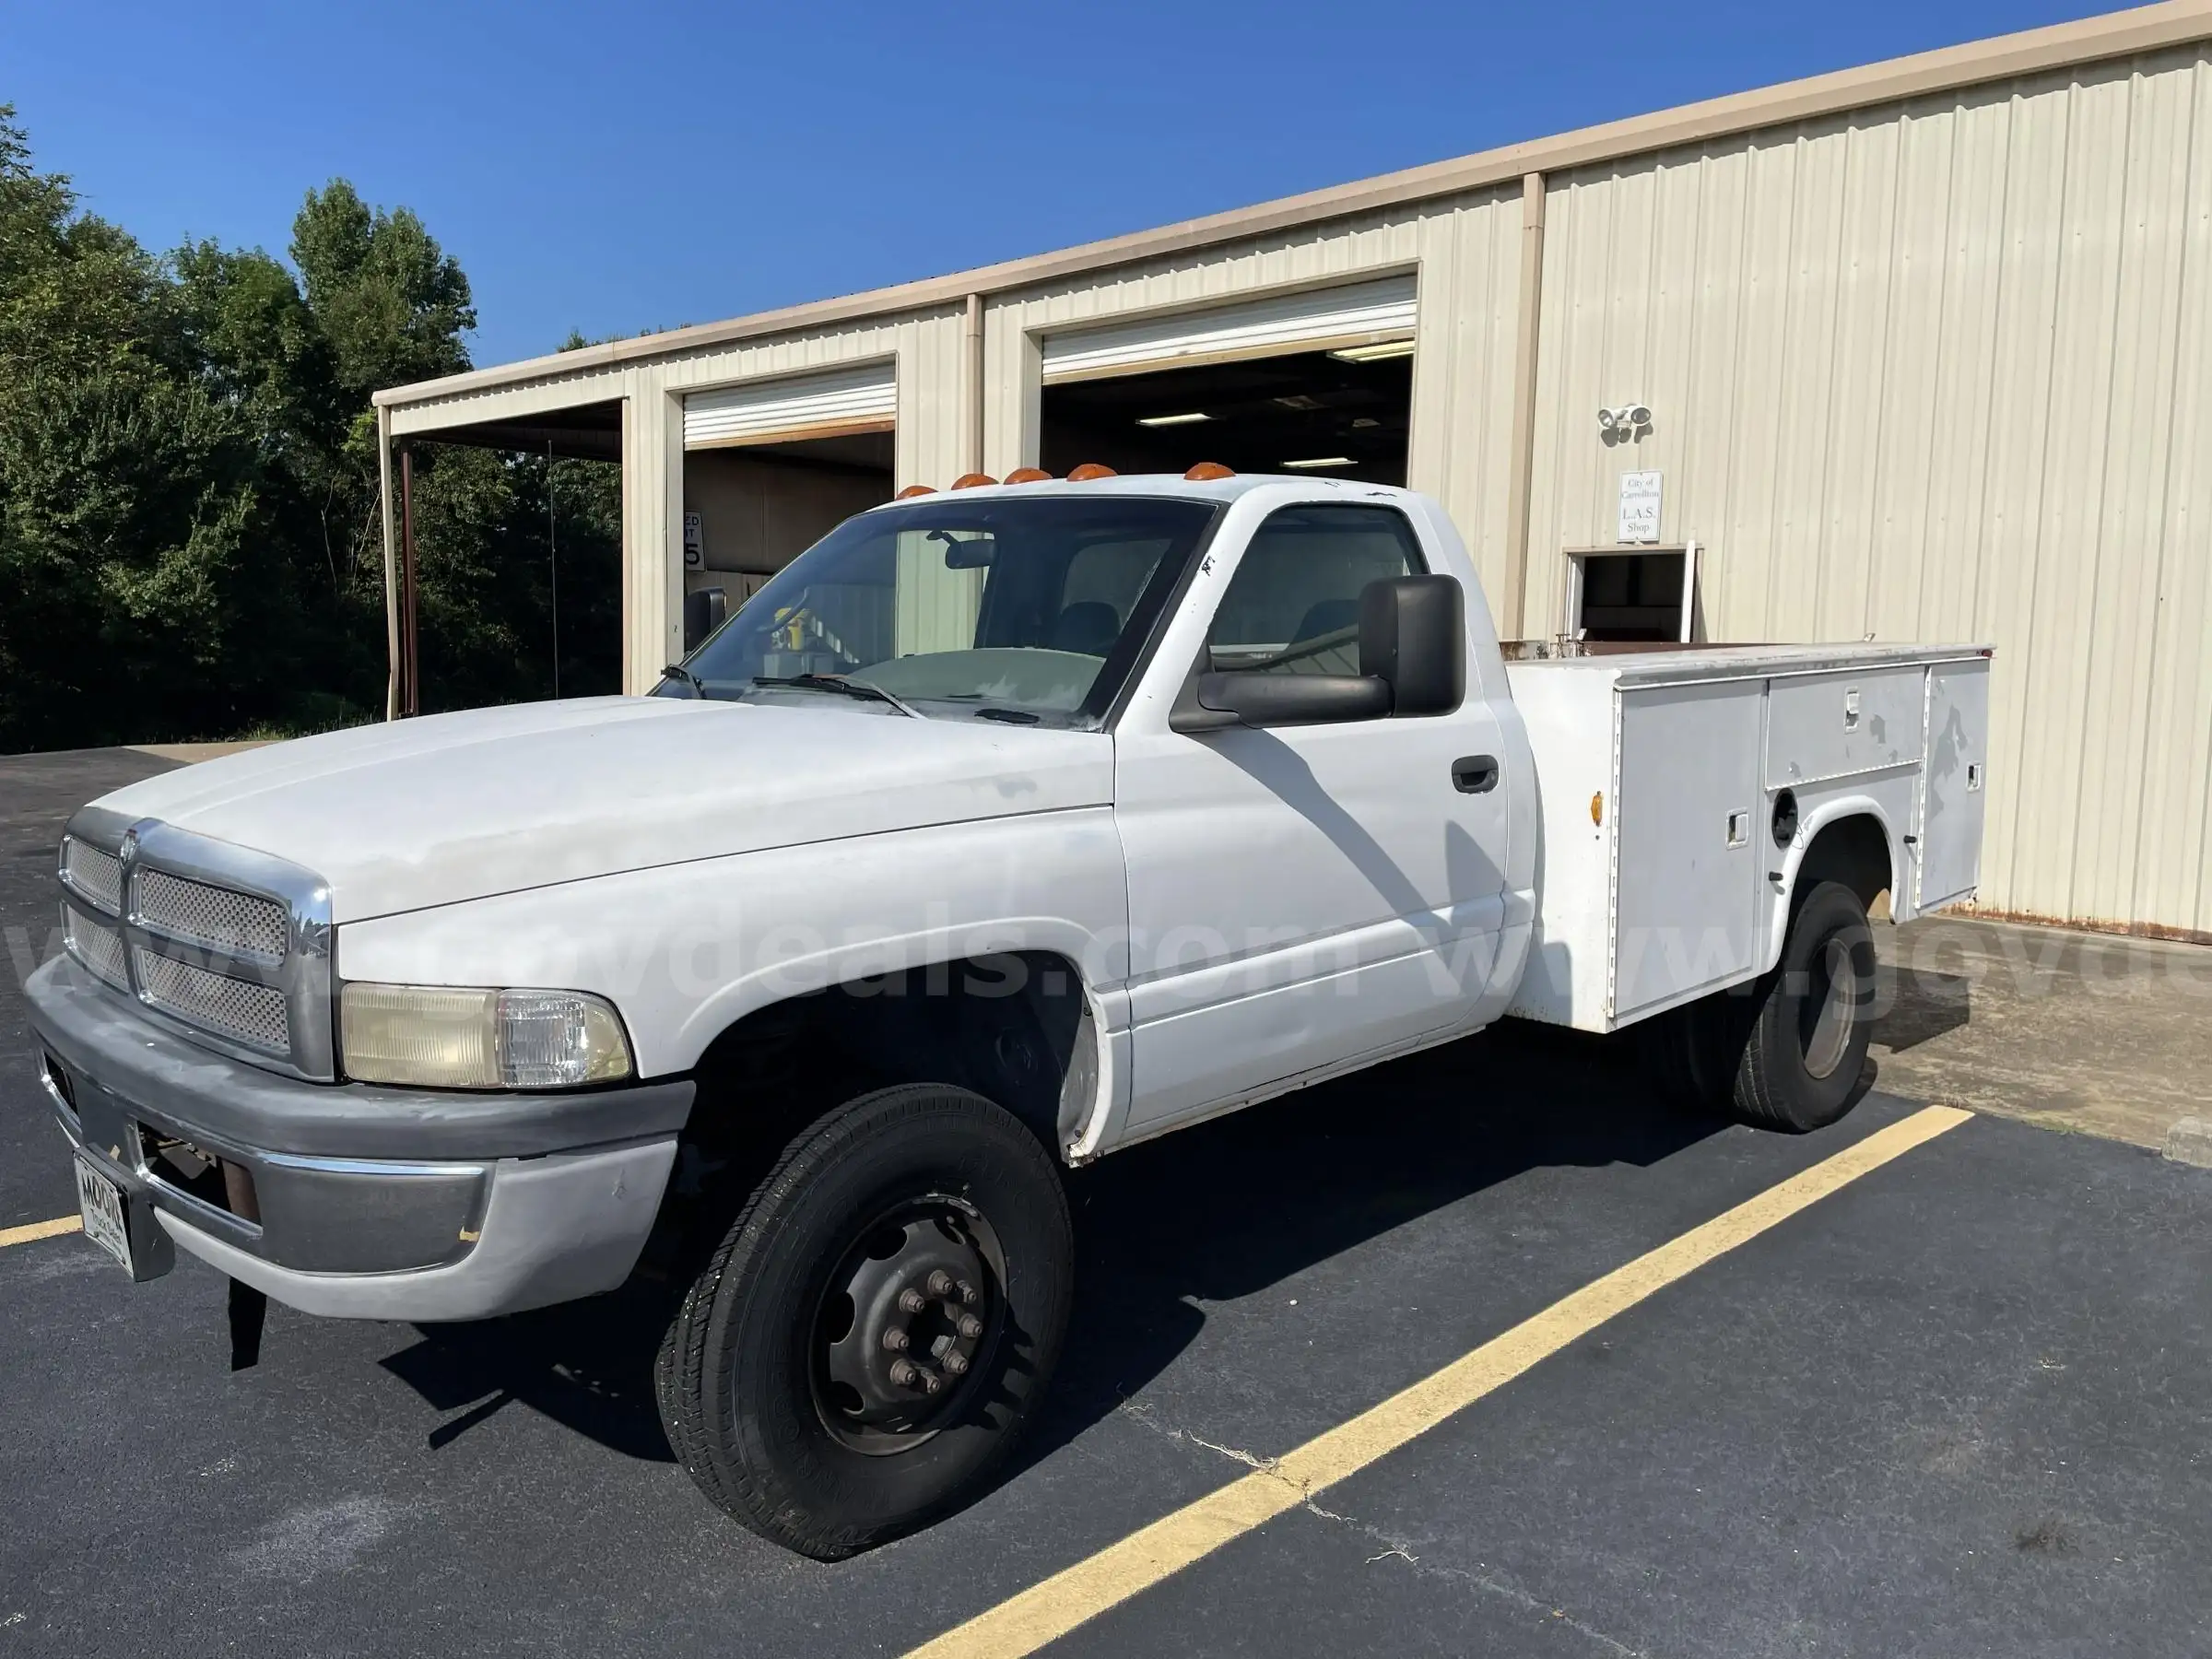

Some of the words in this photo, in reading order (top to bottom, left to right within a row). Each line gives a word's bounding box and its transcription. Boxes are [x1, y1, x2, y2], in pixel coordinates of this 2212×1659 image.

[1628, 478, 1642, 488] City
[1645, 477, 1653, 487] of
[1622, 489, 1659, 500] Carrollton
[1628, 523, 1650, 535] Shop
